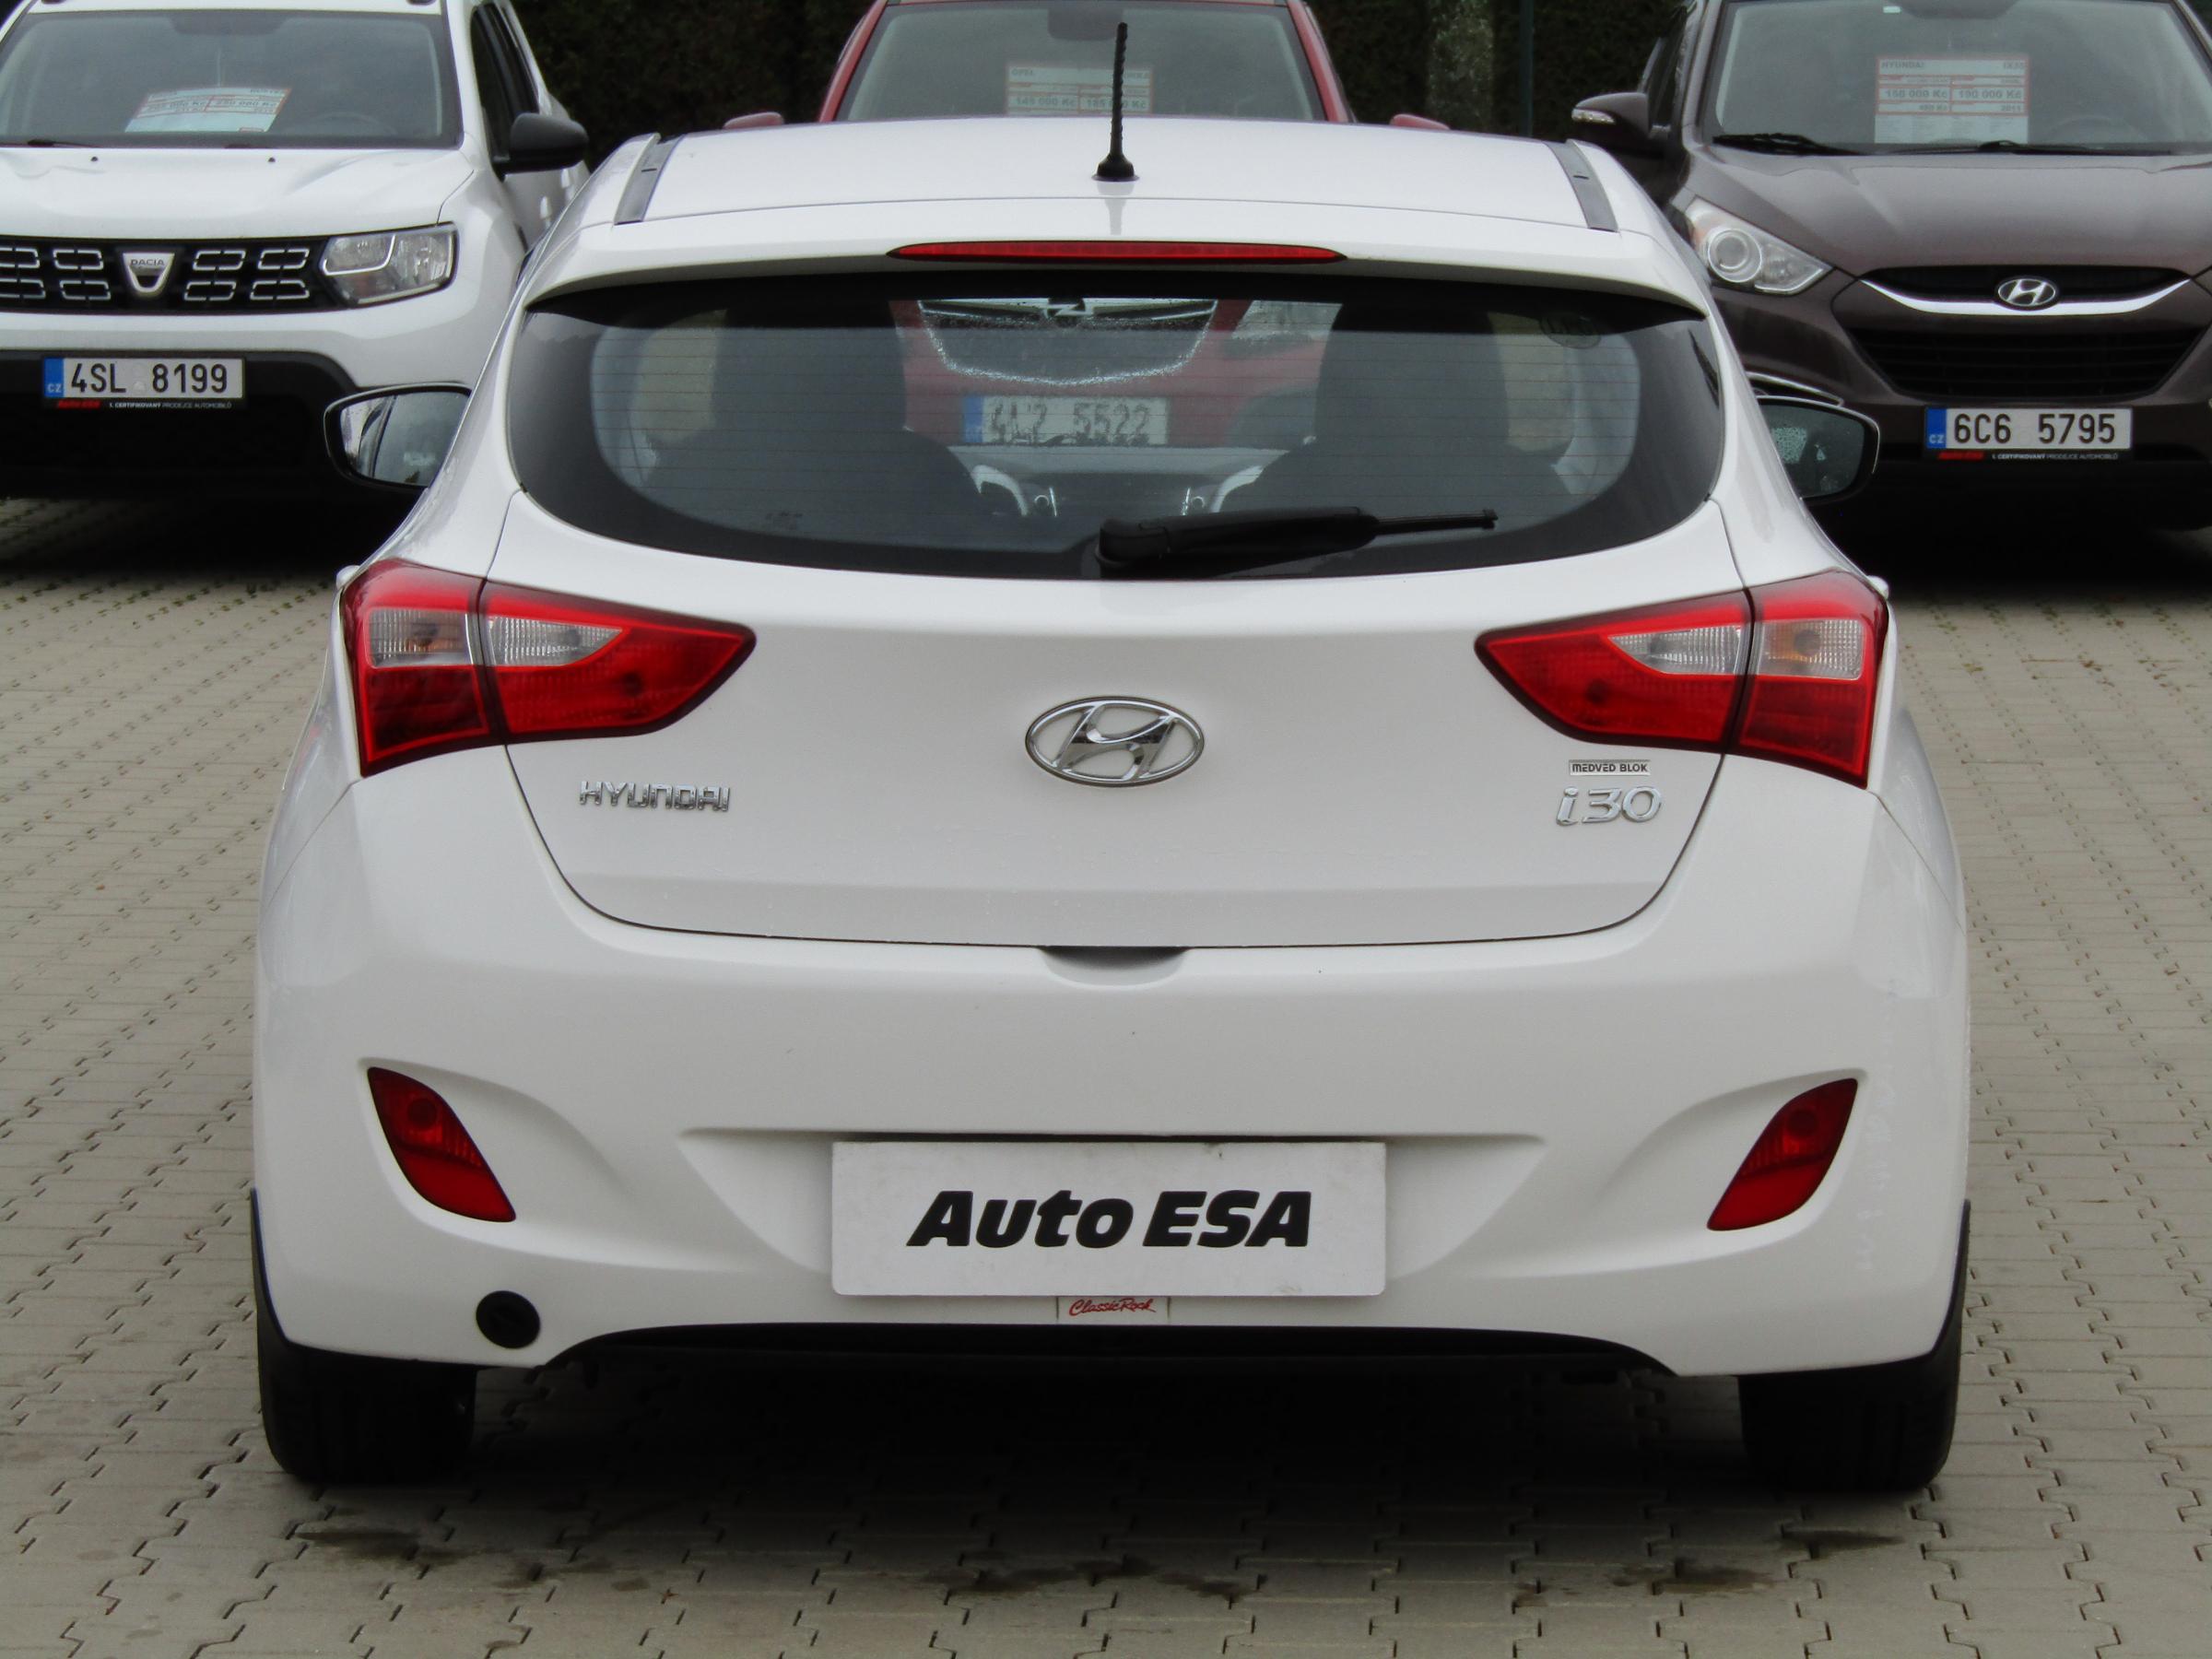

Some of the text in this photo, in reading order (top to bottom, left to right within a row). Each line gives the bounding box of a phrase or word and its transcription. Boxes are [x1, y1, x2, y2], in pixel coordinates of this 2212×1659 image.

[47, 382, 63, 393] CZ
[71, 363, 228, 393] 4SL 8199
[1929, 435, 1945, 444] CZ
[1954, 413, 2115, 444] 6C6 5795
[1572, 763, 1648, 772] MEDVED BLOK
[579, 781, 730, 812] HYUNDAI
[1556, 786, 1663, 827] i30
[905, 1189, 1312, 1249] Auto ESA
